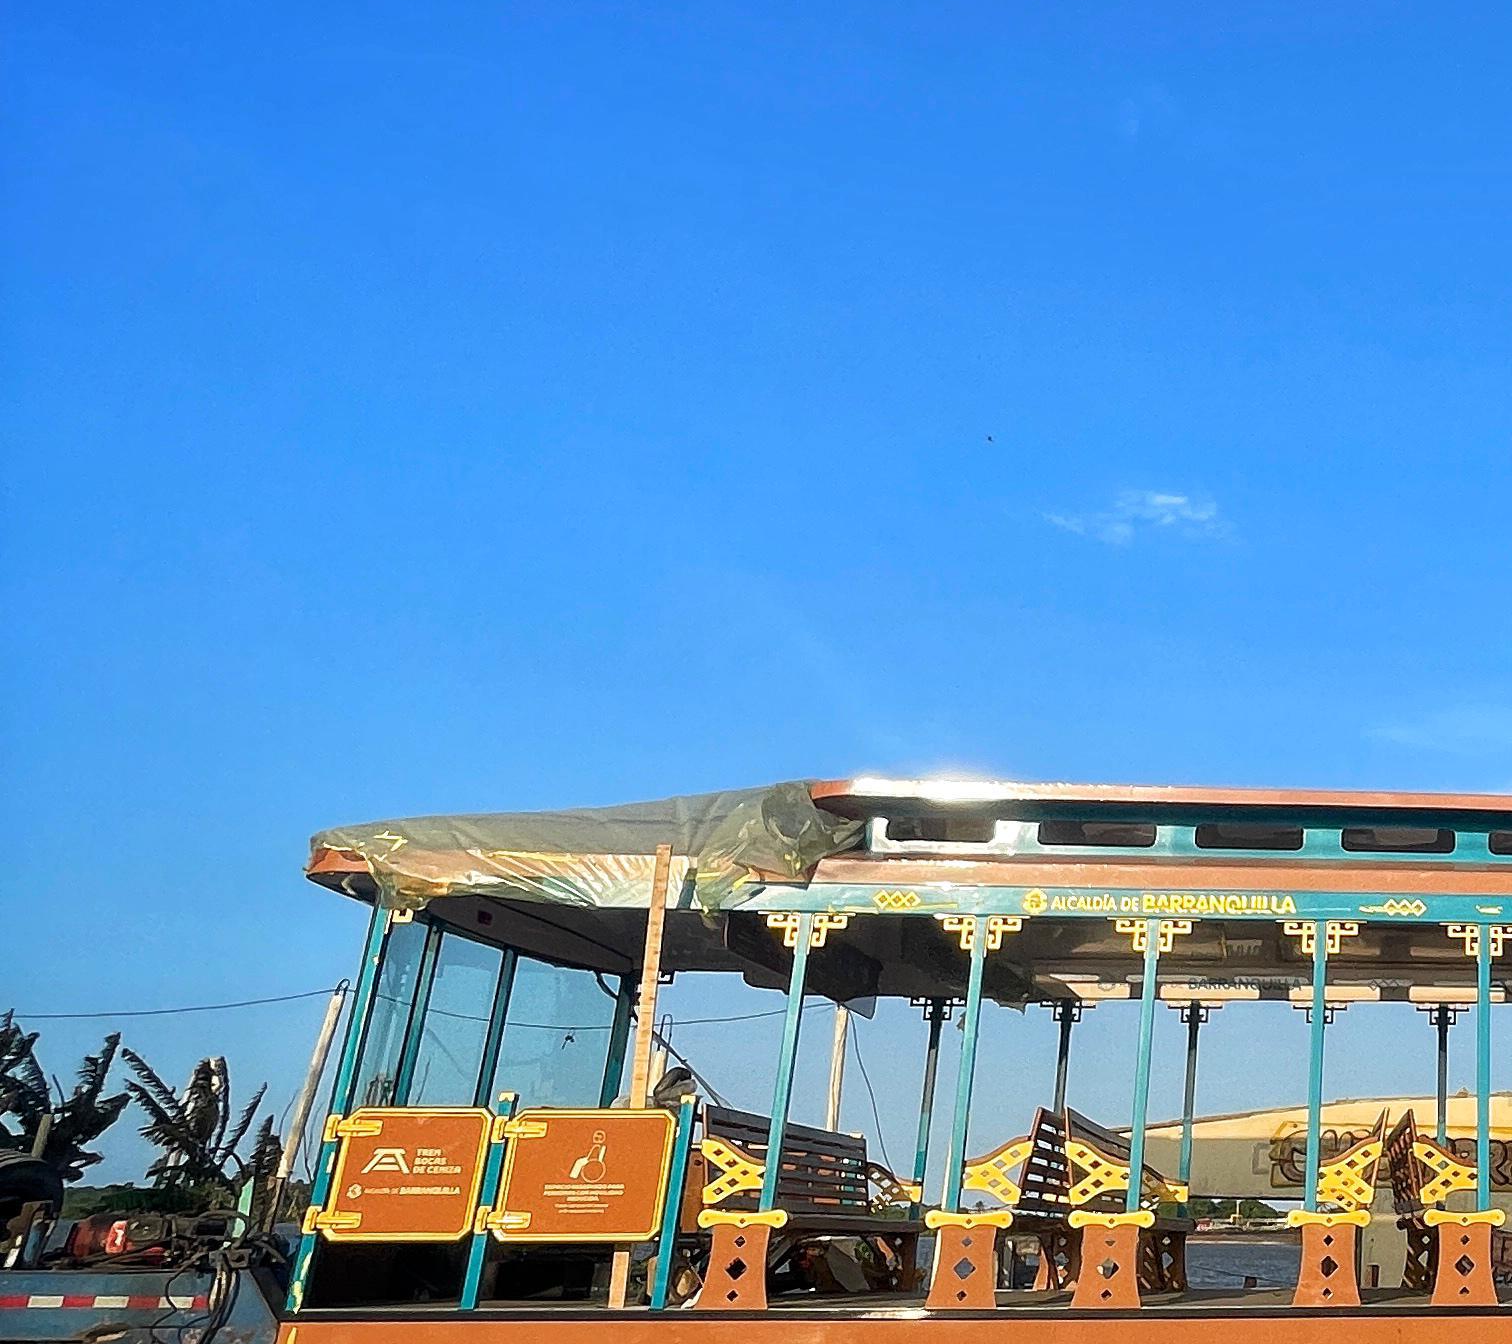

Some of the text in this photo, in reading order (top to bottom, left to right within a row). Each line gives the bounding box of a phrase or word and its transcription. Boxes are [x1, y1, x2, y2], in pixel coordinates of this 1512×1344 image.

[1051, 893, 1296, 914] ALCALDÍA DE BARRANQUILLA
